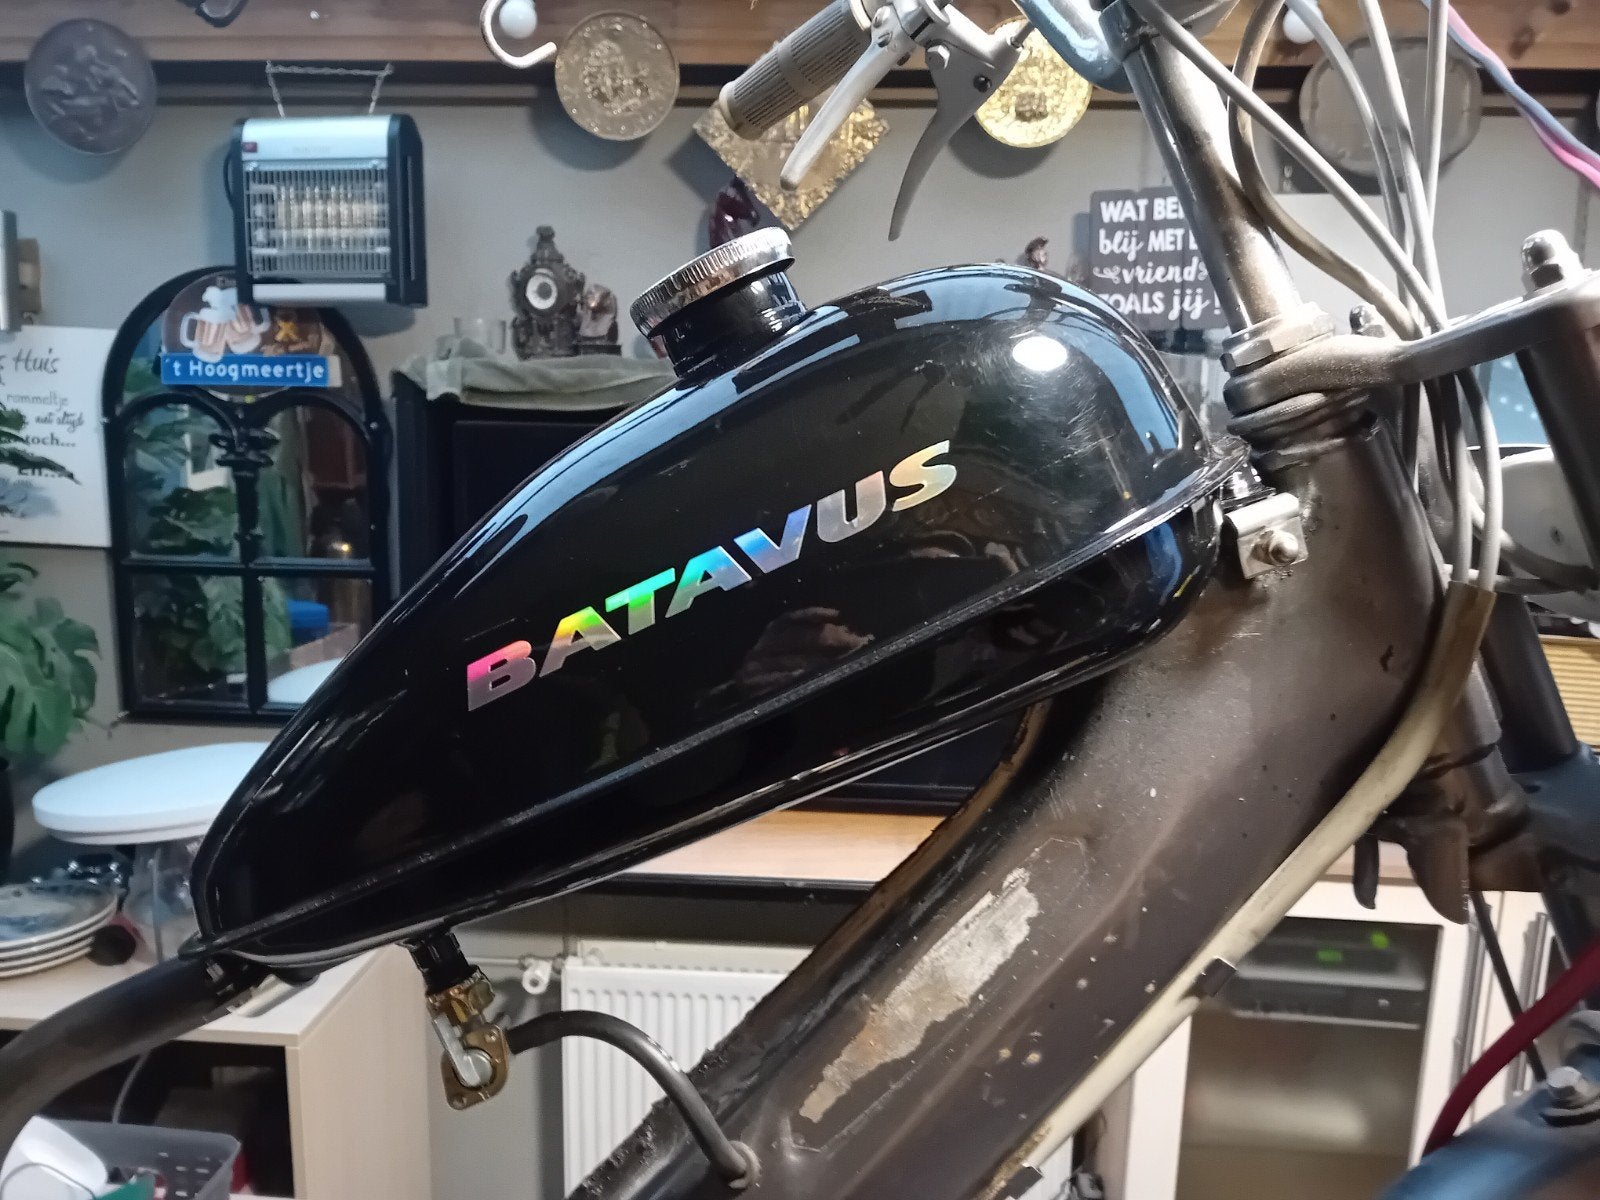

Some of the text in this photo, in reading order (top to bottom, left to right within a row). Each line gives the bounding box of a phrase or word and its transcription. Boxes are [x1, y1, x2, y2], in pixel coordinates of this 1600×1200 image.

[1100, 198, 1149, 223] WAT
[1098, 228, 1144, 262] blij
[1147, 227, 1185, 253] MET
[1167, 287, 1211, 321] jij
[12, 348, 60, 374] Huis
[189, 359, 325, 384] Hoogmeertje
[467, 440, 957, 711] BATAVUS
